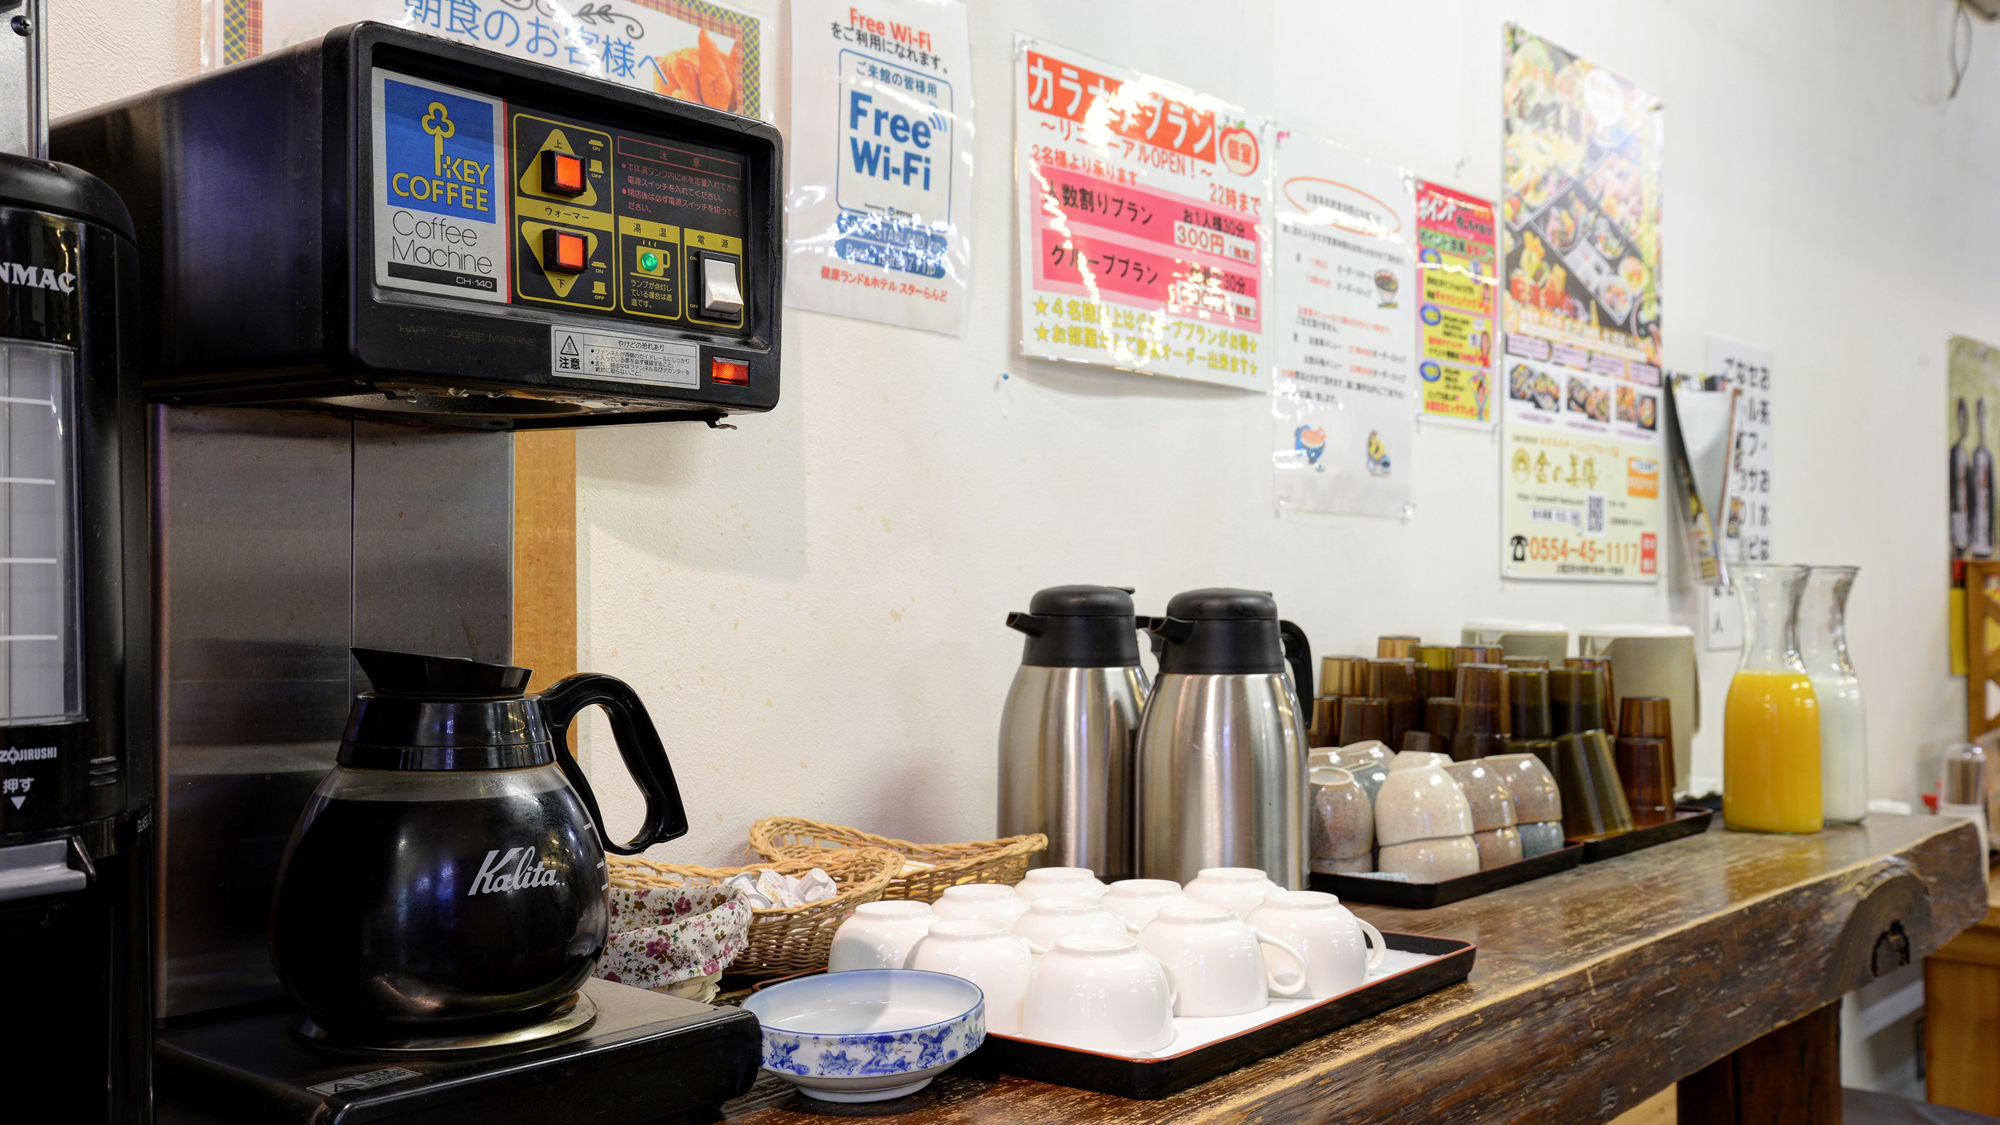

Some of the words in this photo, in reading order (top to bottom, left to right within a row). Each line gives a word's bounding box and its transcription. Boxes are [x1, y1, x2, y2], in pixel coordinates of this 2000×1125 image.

[850, 7, 886, 36] Free
[890, 20, 932, 52] Wi-Fi
[831, 22, 948, 74] をご利用になれます。
[856, 60, 937, 98] ご来館の皆様用
[850, 90, 931, 149] Free
[1028, 57, 1213, 155] カラプラン
[554, 139, 563, 150] 上
[443, 156, 491, 185] KEY
[850, 136, 931, 192] Wi-Fi
[1032, 144, 1138, 187] 2名様より承ります
[392, 172, 489, 212] COFFEE
[628, 201, 652, 213] ださい。
[1045, 180, 1153, 225] 人数割りプラン
[1210, 183, 1261, 216] 22時まで
[392, 210, 478, 247] Coffee
[544, 206, 590, 220] ウォーマー
[392, 236, 493, 275] Machine
[1177, 225, 1224, 255] 300円
[455, 276, 493, 289] CH-140
[557, 279, 565, 288] 下
[900, 282, 948, 302] スターらんど
[559, 356, 580, 370] 注意
[1530, 536, 1639, 565] 0554-45-1117
[0, 746, 57, 765] ZOJIRUSHI
[3, 777, 34, 794] 押す
[468, 845, 557, 896] Kalita
